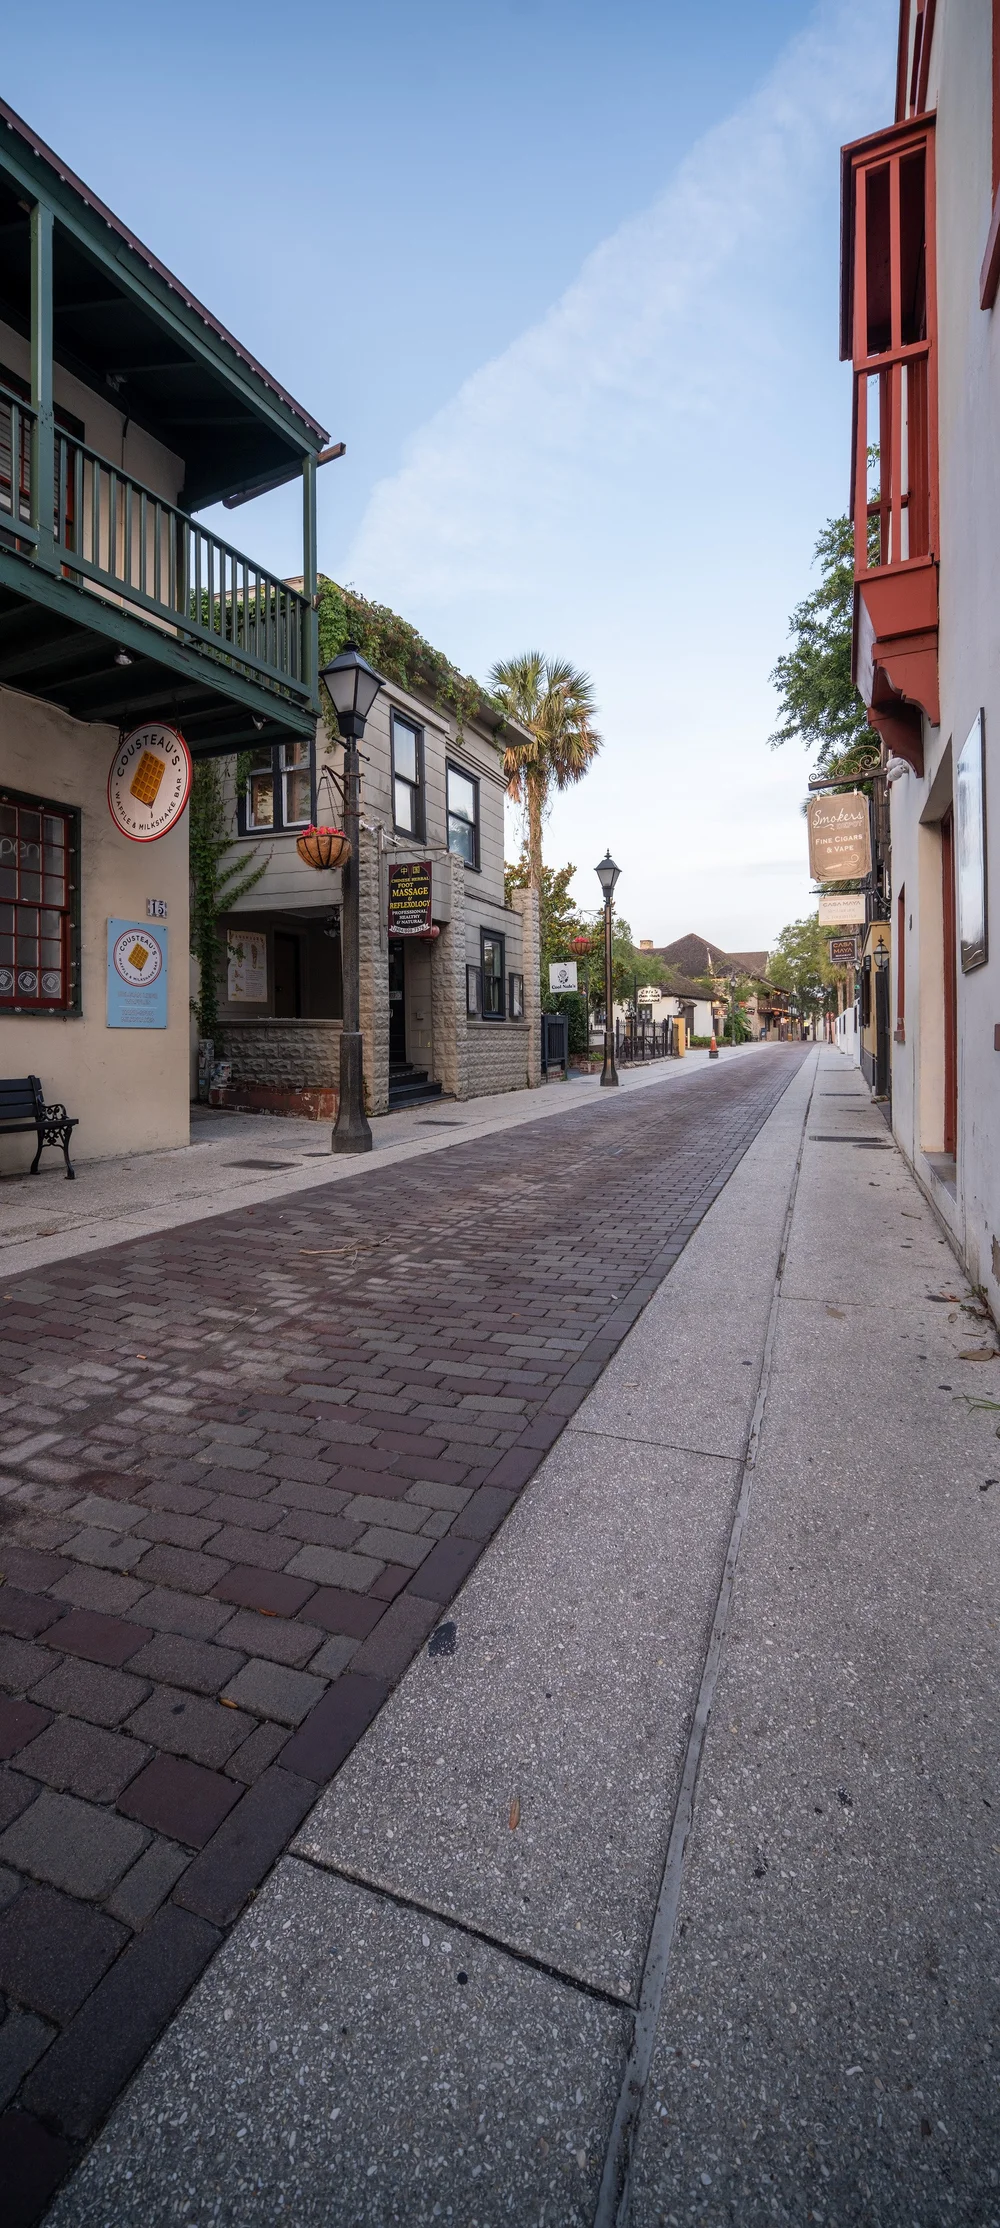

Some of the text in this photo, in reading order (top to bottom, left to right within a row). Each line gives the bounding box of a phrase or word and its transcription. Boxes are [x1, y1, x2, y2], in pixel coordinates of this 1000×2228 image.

[117, 734, 180, 777] COUSTEAU'S
[115, 777, 182, 830] WAFFLE & MILKSHAKE BAR
[812, 808, 864, 826] Smokers
[0, 838, 40, 859] pen
[815, 834, 863, 845] FINE CIGARS
[392, 887, 428, 897] MASSAGE
[152, 900, 164, 915] 15
[389, 900, 430, 909] REFLEXOLOGY
[119, 935, 157, 956] COUSTEAU'S
